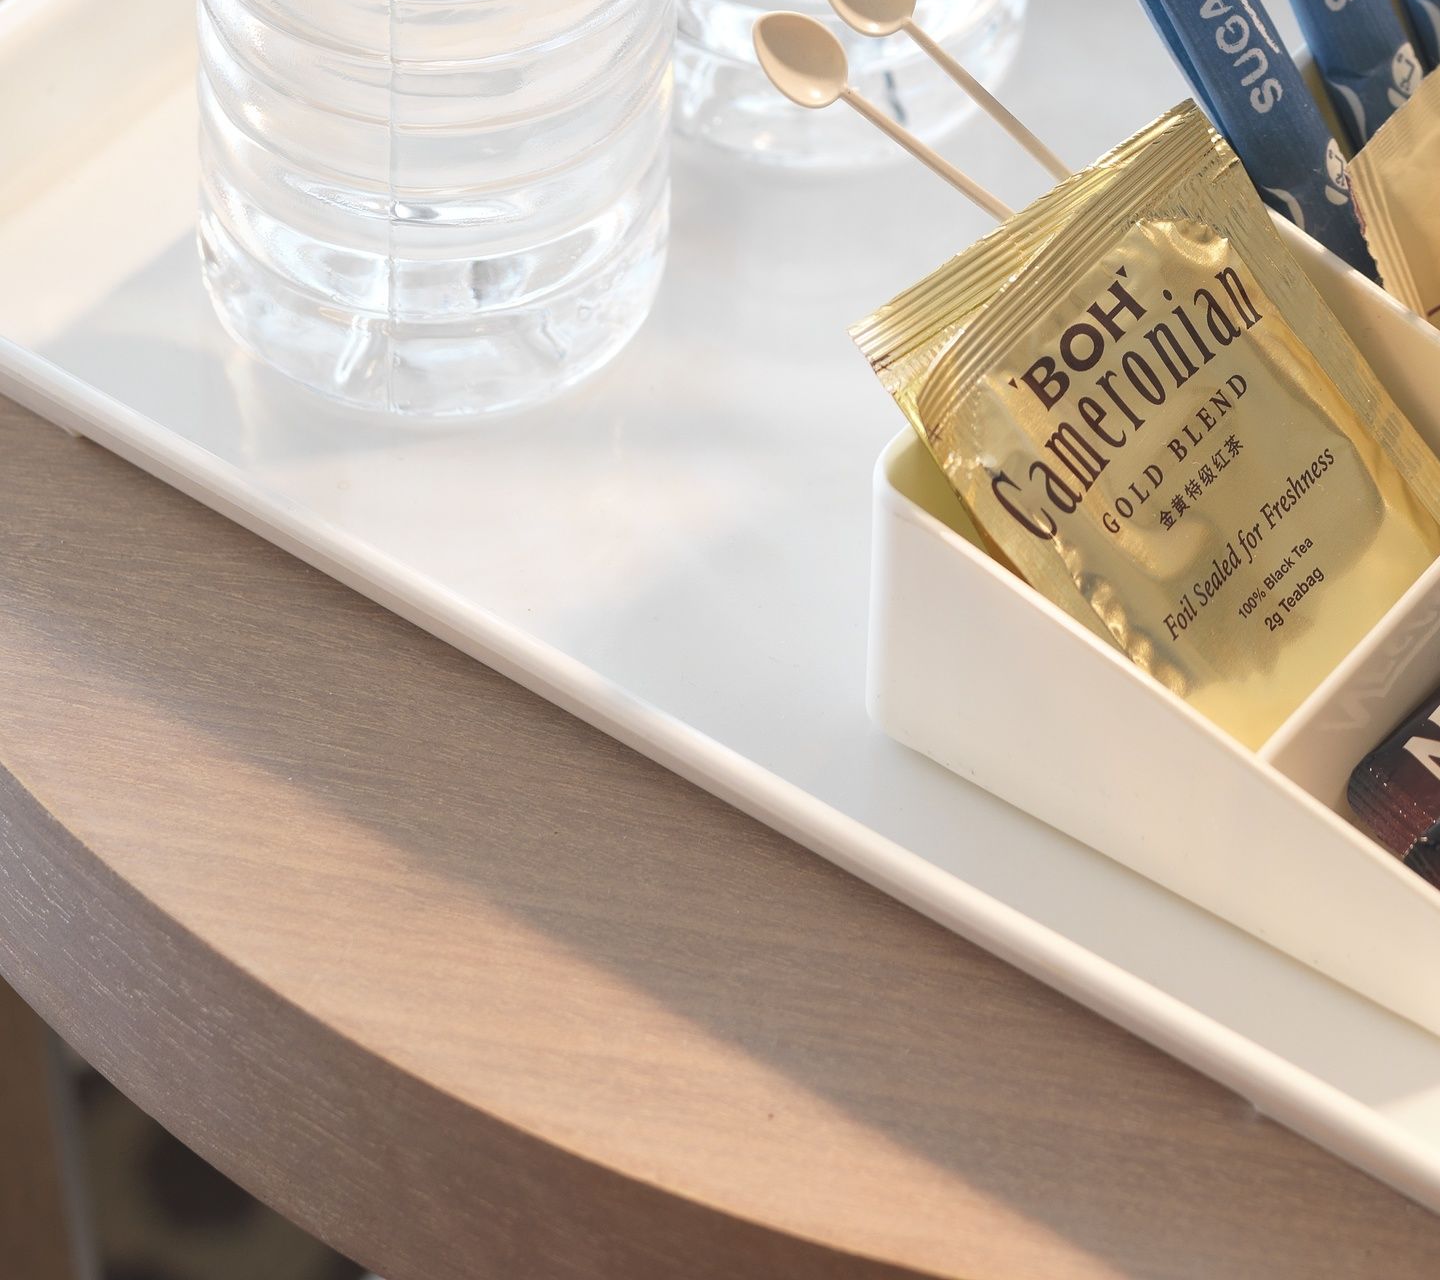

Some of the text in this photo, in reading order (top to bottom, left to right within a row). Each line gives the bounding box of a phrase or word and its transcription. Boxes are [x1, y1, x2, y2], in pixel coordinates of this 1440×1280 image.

[991, 264, 1264, 542] Cameronian
[1102, 373, 1248, 535] GOLD BLEND
[1158, 433, 1245, 532] 金黄特级红茶
[1162, 447, 1336, 641] Foil Sealed for Freshness
[1238, 537, 1315, 620] 100% Black Tea
[1263, 566, 1326, 633] 2g Teabag
